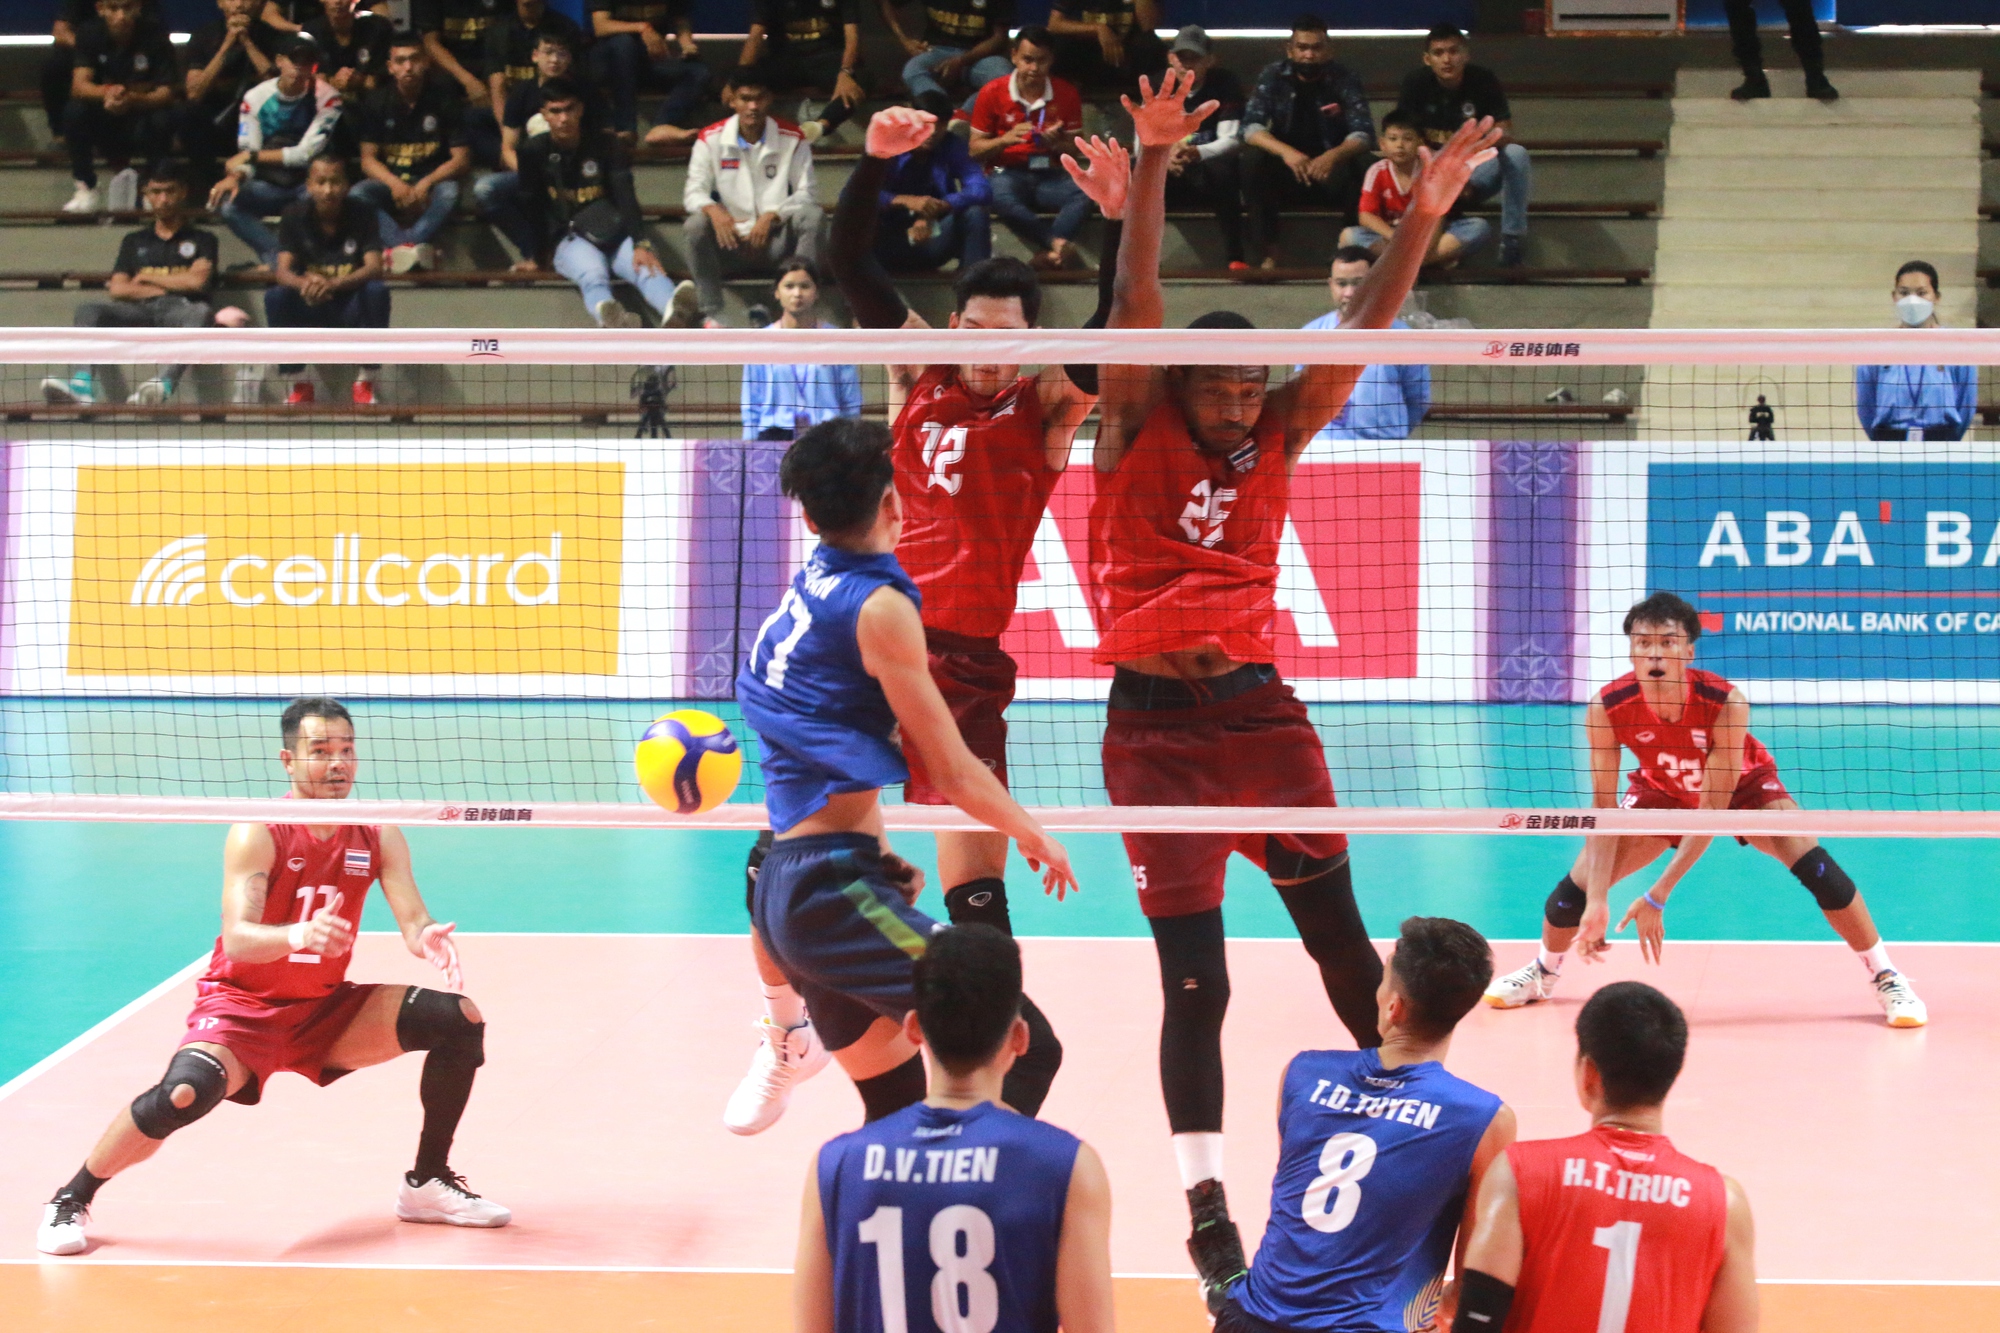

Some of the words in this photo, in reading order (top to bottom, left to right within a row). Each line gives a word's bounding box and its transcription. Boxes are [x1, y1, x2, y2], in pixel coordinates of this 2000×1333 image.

[1509, 342, 1580, 357] 金陵体育
[920, 420, 969, 496] 12
[220, 531, 562, 607] cellcard
[749, 587, 813, 690] 17
[1735, 611, 1855, 632] NATIONAL
[1861, 611, 1929, 632] BANK
[1935, 611, 1969, 632] OF
[464, 807, 533, 822] 金陵体育
[1526, 815, 1597, 829] 金陵体育
[1309, 1078, 1443, 1131] T.D.TUYEN
[863, 1143, 999, 1184] D.V.TIEN
[1301, 1131, 1378, 1234] 8
[1562, 1158, 1692, 1208] H.T.TRUC
[857, 1203, 999, 1333] 18
[1591, 1219, 1643, 1333] 1
